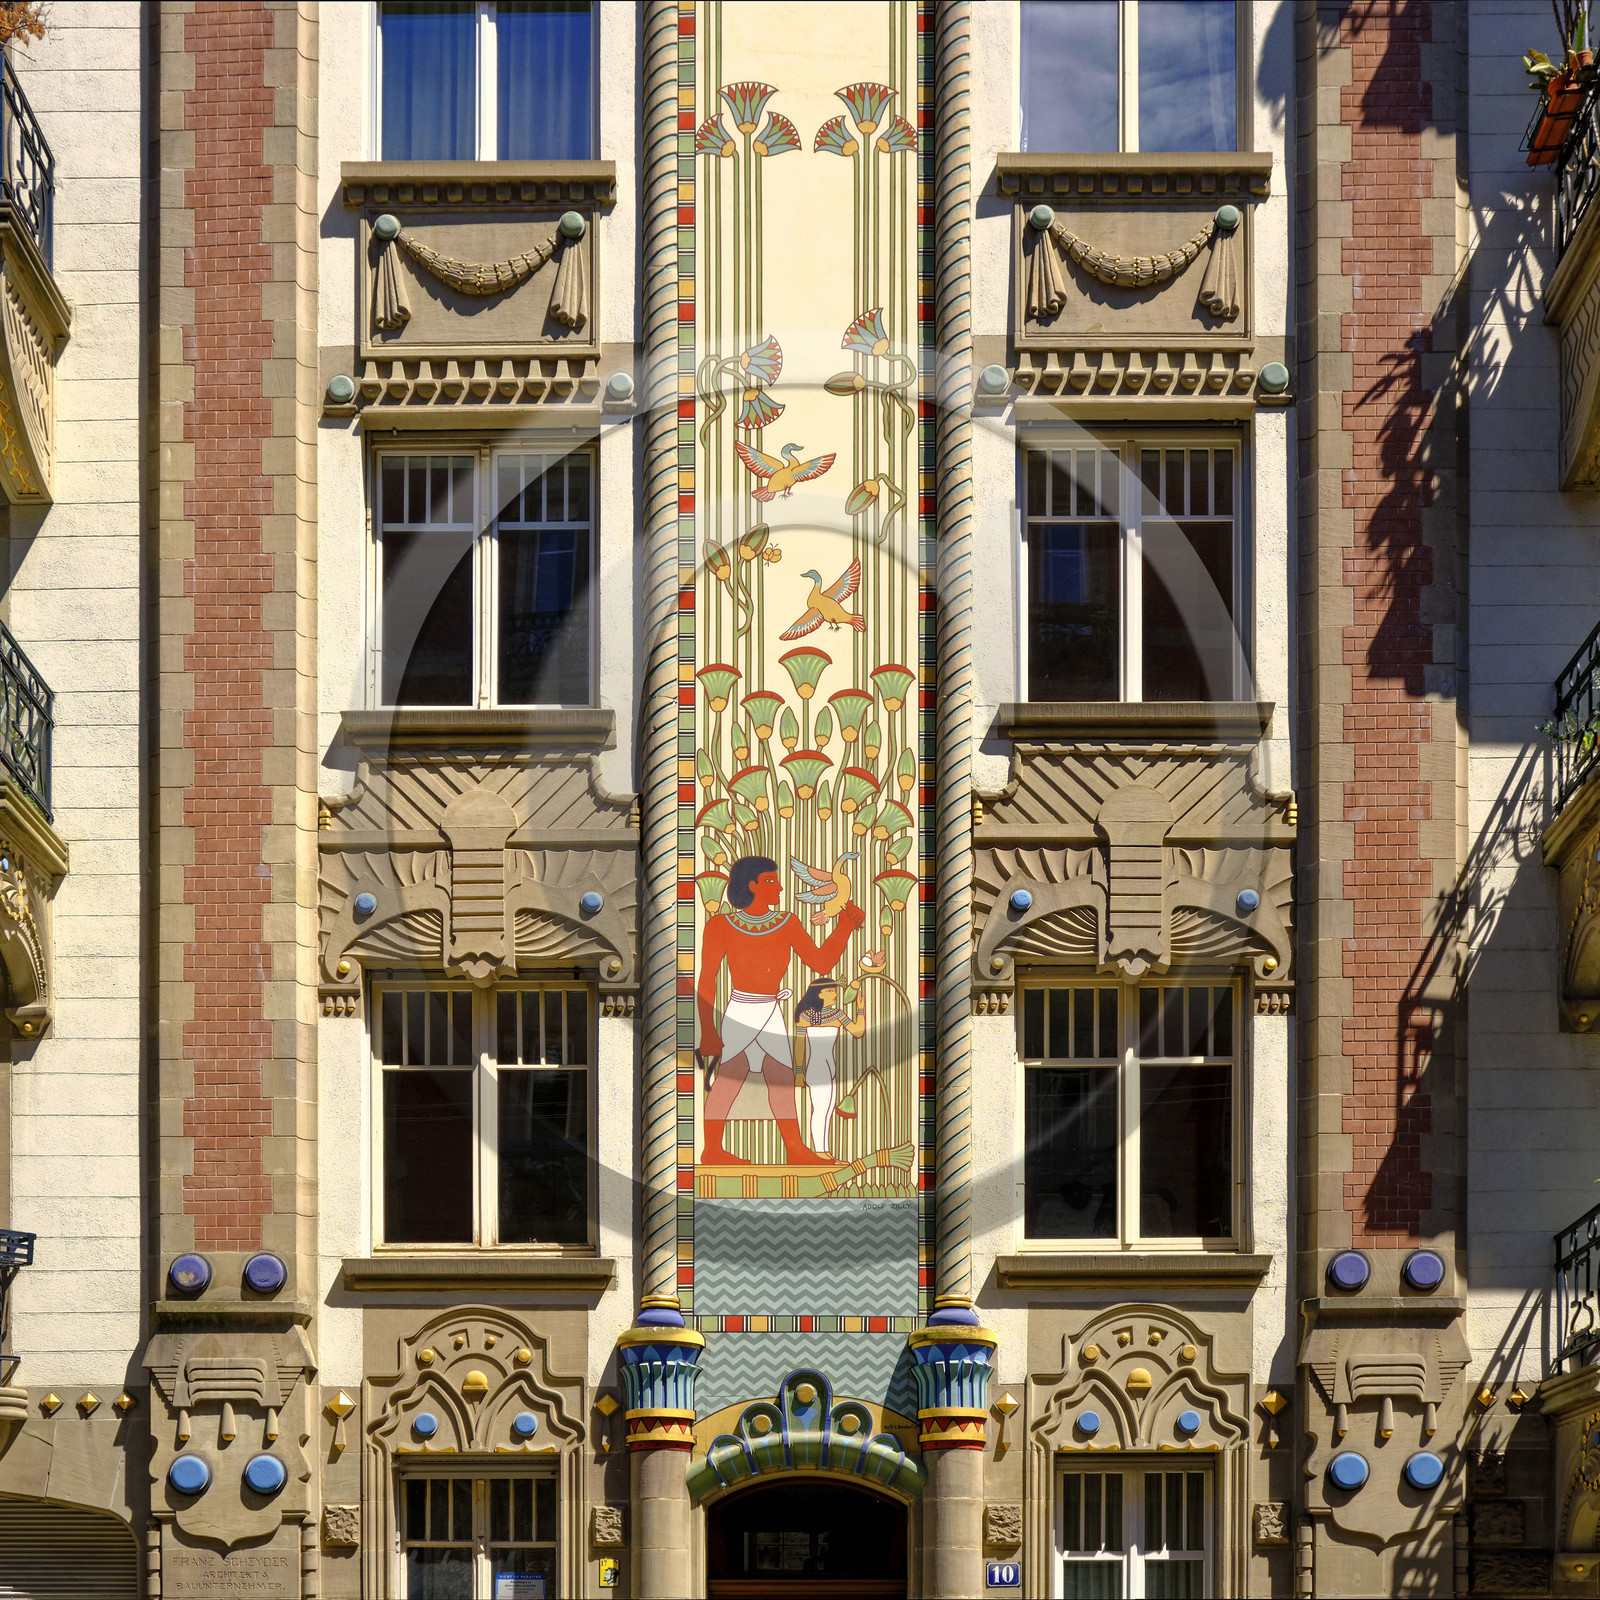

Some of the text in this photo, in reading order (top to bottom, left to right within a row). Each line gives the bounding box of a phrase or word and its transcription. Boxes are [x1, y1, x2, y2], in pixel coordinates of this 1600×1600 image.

[172, 1556, 215, 1567] FRANZ
[202, 1570, 269, 1580] ARCHITEKT &
[992, 1565, 1014, 1583] 10
